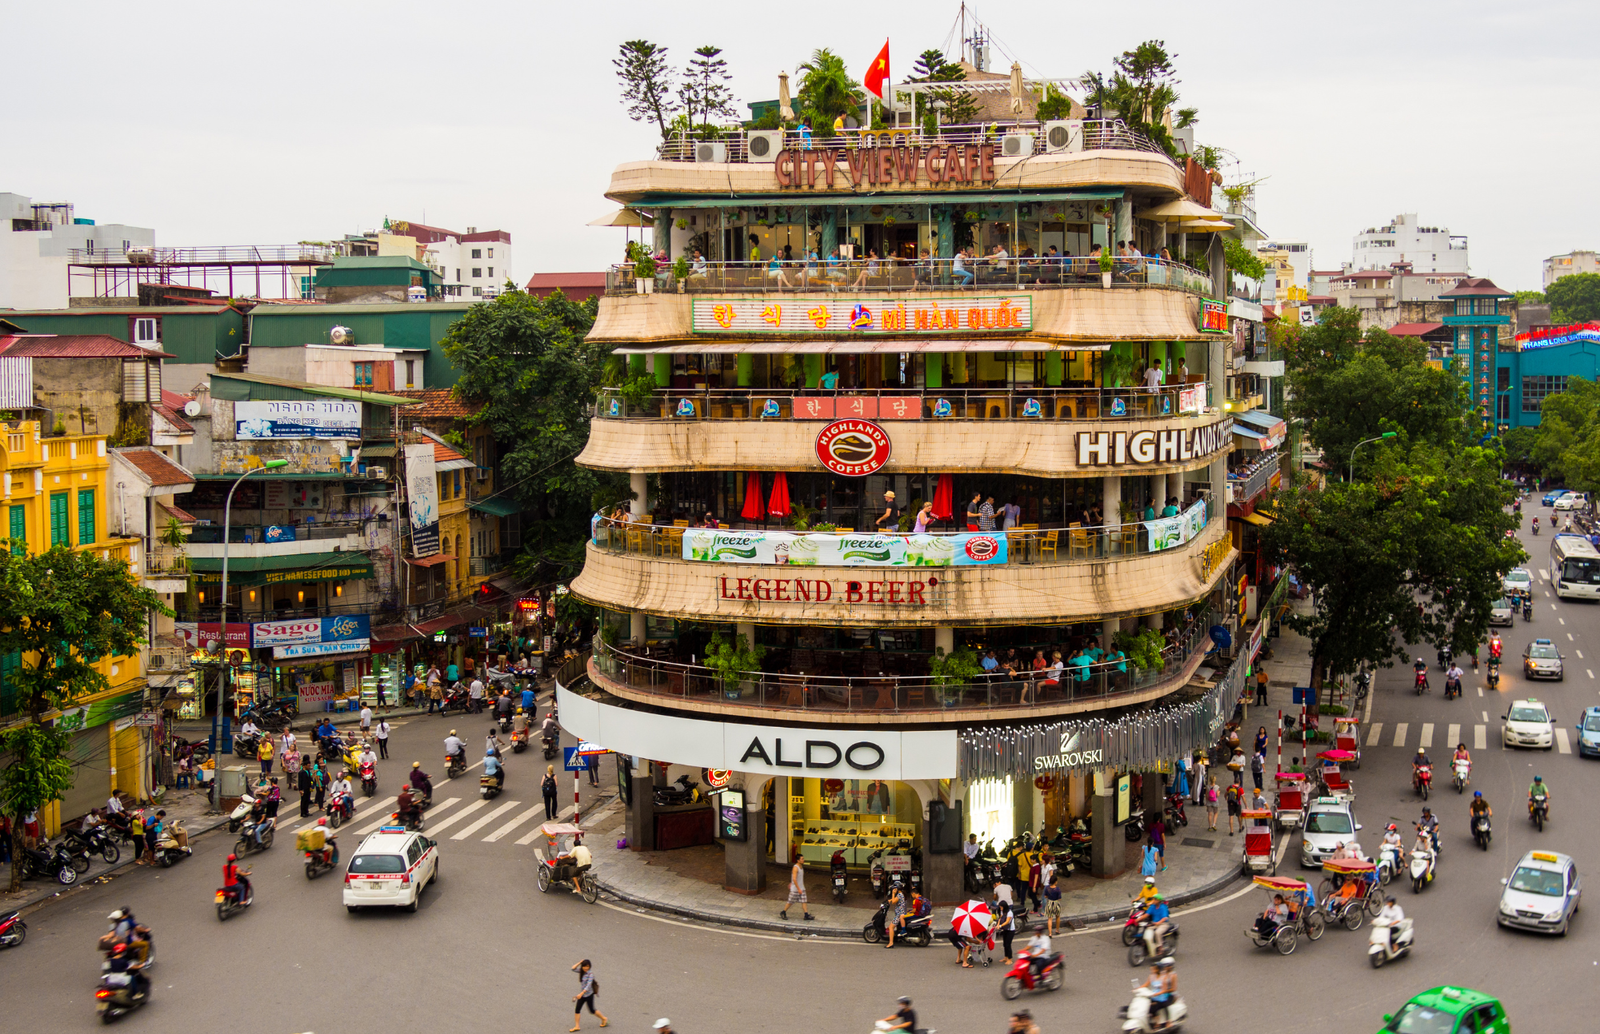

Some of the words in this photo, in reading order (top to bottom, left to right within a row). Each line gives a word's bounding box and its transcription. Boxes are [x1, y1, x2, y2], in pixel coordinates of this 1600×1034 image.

[775, 149, 839, 186] CITY
[846, 146, 921, 184] VIEW
[925, 144, 995, 183] CAFE
[881, 303, 906, 330] MÌ
[914, 302, 959, 330] HÀN
[967, 299, 1023, 330] QUỐC
[1548, 336, 1568, 345] LONG
[820, 422, 886, 446] HIGHLANDS
[1077, 425, 1216, 467] HIGHLANDS
[828, 460, 879, 474] COFFEE
[712, 533, 751, 547] freeze
[838, 537, 884, 551] freeze
[966, 536, 998, 548] HIGHLANDS
[970, 552, 994, 561] COFFEE
[201, 573, 230, 582] COFFE
[721, 577, 832, 602] LEGEND
[846, 581, 926, 605] BEER
[255, 623, 319, 637] Sago
[329, 619, 359, 638] Tiger
[740, 736, 885, 771] ALDO
[1034, 749, 1103, 770] SWAROVSKI
